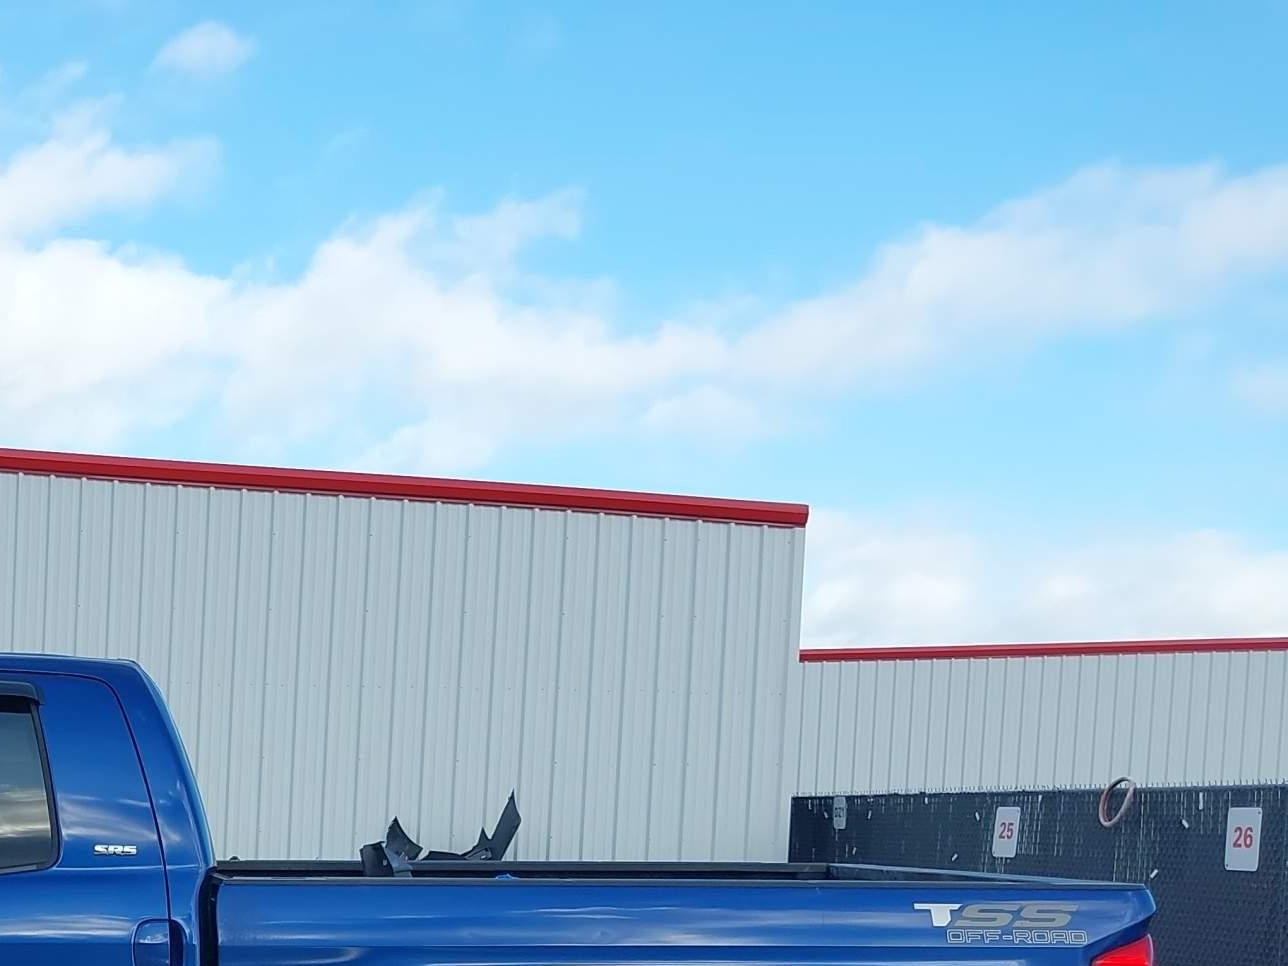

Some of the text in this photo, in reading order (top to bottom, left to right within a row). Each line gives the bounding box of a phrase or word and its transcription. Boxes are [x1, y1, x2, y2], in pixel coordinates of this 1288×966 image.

[999, 822, 1014, 839] 25
[1233, 826, 1253, 848] 26
[914, 903, 1080, 927] TSS
[947, 929, 1087, 944] OFF-ROAD
